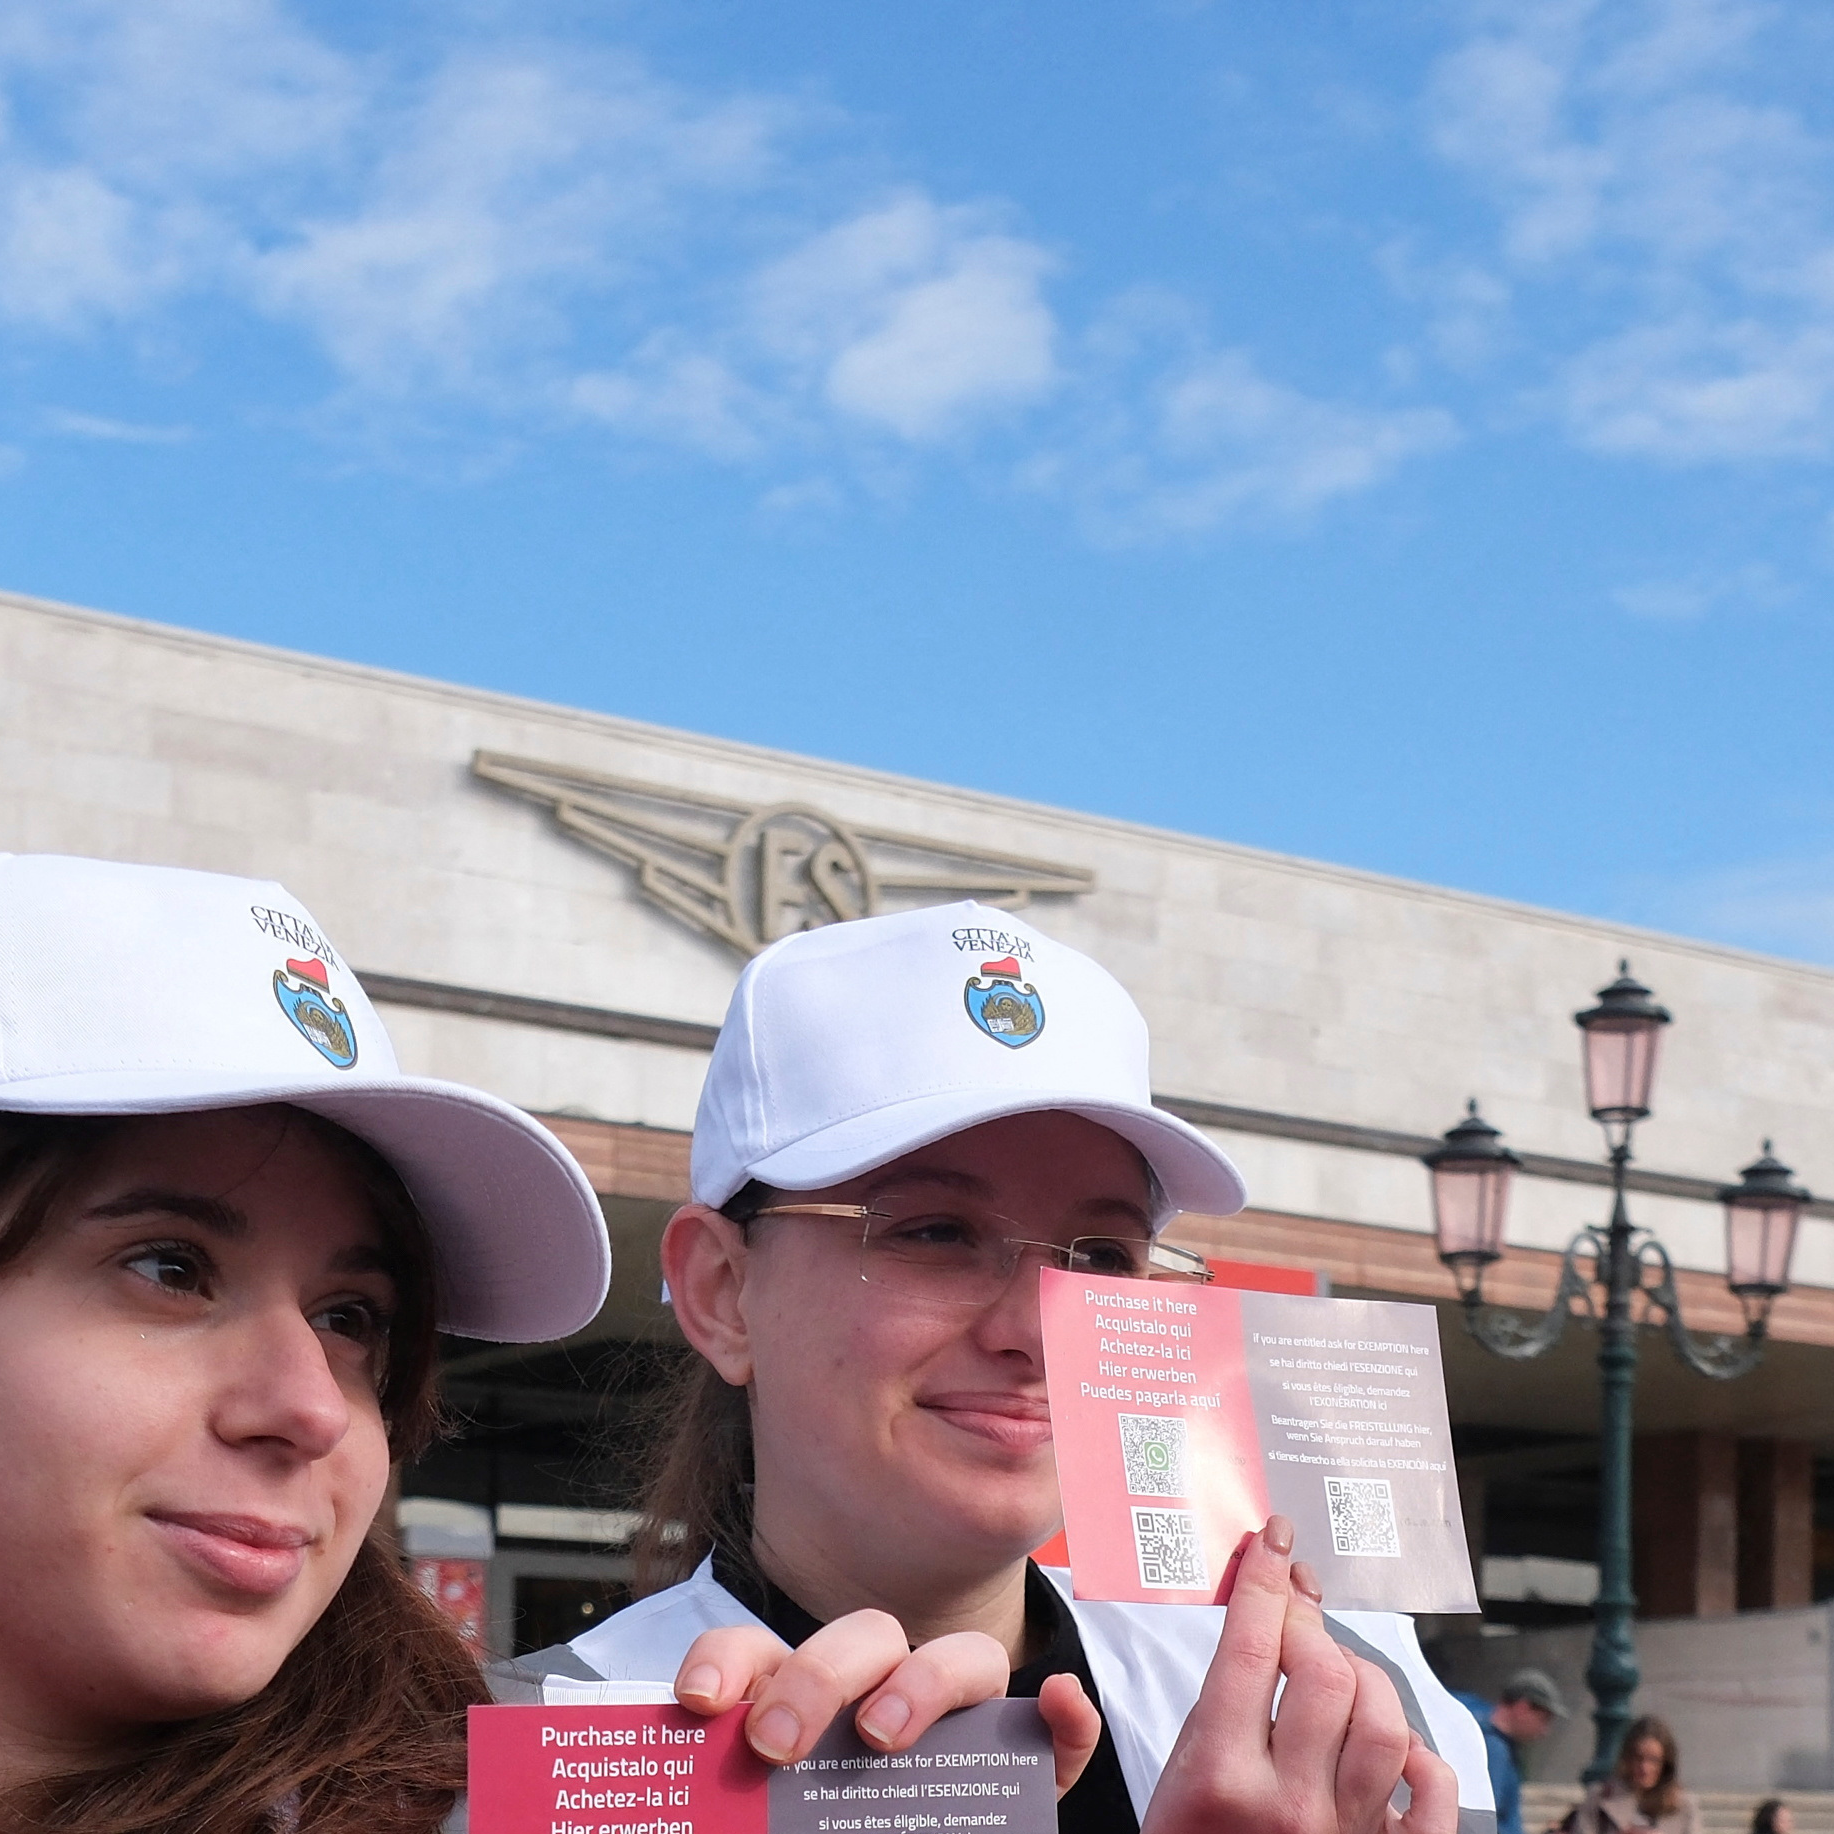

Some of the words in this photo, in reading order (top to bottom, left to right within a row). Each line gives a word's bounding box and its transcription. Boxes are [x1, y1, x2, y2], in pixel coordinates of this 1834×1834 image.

[252, 917, 340, 972] VENEZIA
[953, 940, 1035, 963] VENEZIA
[1014, 935, 1031, 952] DI
[1085, 1289, 1149, 1310] Purchase
[1152, 1296, 1163, 1312] it
[1165, 1297, 1197, 1315] here
[1095, 1313, 1167, 1335] Acquistalo
[1170, 1322, 1191, 1340] qui
[1100, 1337, 1173, 1359] Achetez-la
[1175, 1344, 1191, 1360] ici
[1253, 1332, 1259, 1343] if
[1260, 1336, 1277, 1346] you
[1278, 1337, 1292, 1345] are
[1293, 1337, 1326, 1348] entitled
[1327, 1339, 1343, 1349] ask
[1343, 1339, 1356, 1350] for
[1357, 1340, 1409, 1354] EXEMPTION
[1410, 1344, 1429, 1355] here
[1099, 1360, 1128, 1377] Hier
[1131, 1367, 1196, 1384] erwerben
[1269, 1358, 1280, 1367] se
[1281, 1357, 1294, 1368] hai
[1295, 1358, 1322, 1370] diritto
[1323, 1360, 1348, 1371] chiedi
[1349, 1362, 1403, 1375] l'ESENZIONE
[1404, 1368, 1418, 1378] qui
[1080, 1382, 1132, 1401] Puedes
[1135, 1390, 1188, 1407] pagarla
[1190, 1392, 1220, 1411] aquí
[1286, 1432, 1309, 1442] wenn
[1309, 1432, 1323, 1443] Sie
[1324, 1433, 1364, 1446] Anspruch
[1365, 1436, 1393, 1446] darauf
[1394, 1437, 1421, 1448] haben
[542, 1725, 636, 1747] Purchase
[642, 1725, 656, 1744] it
[661, 1724, 705, 1744] here
[552, 1755, 658, 1783] Acquistalo
[663, 1754, 693, 1780] qui
[794, 1760, 816, 1774] you
[818, 1759, 838, 1770] are
[841, 1757, 888, 1769] entitled
[891, 1756, 912, 1768] ask
[915, 1756, 933, 1768] for
[935, 1753, 1009, 1767] EXEMPTION
[1012, 1753, 1038, 1766] here
[555, 1786, 663, 1809] Achetez-la
[669, 1785, 689, 1805] ici
[803, 1790, 818, 1800] se
[820, 1786, 839, 1800] hai
[841, 1786, 879, 1799] diritto
[881, 1784, 918, 1798] chiedi
[921, 1782, 999, 1797] l'ESENZIONE
[1001, 1782, 1020, 1799] qui
[819, 1816, 829, 1830] si
[831, 1819, 862, 1830] vous
[864, 1815, 891, 1829] êtes
[893, 1813, 941, 1831] éligible,
[943, 1812, 1007, 1826] demandez
